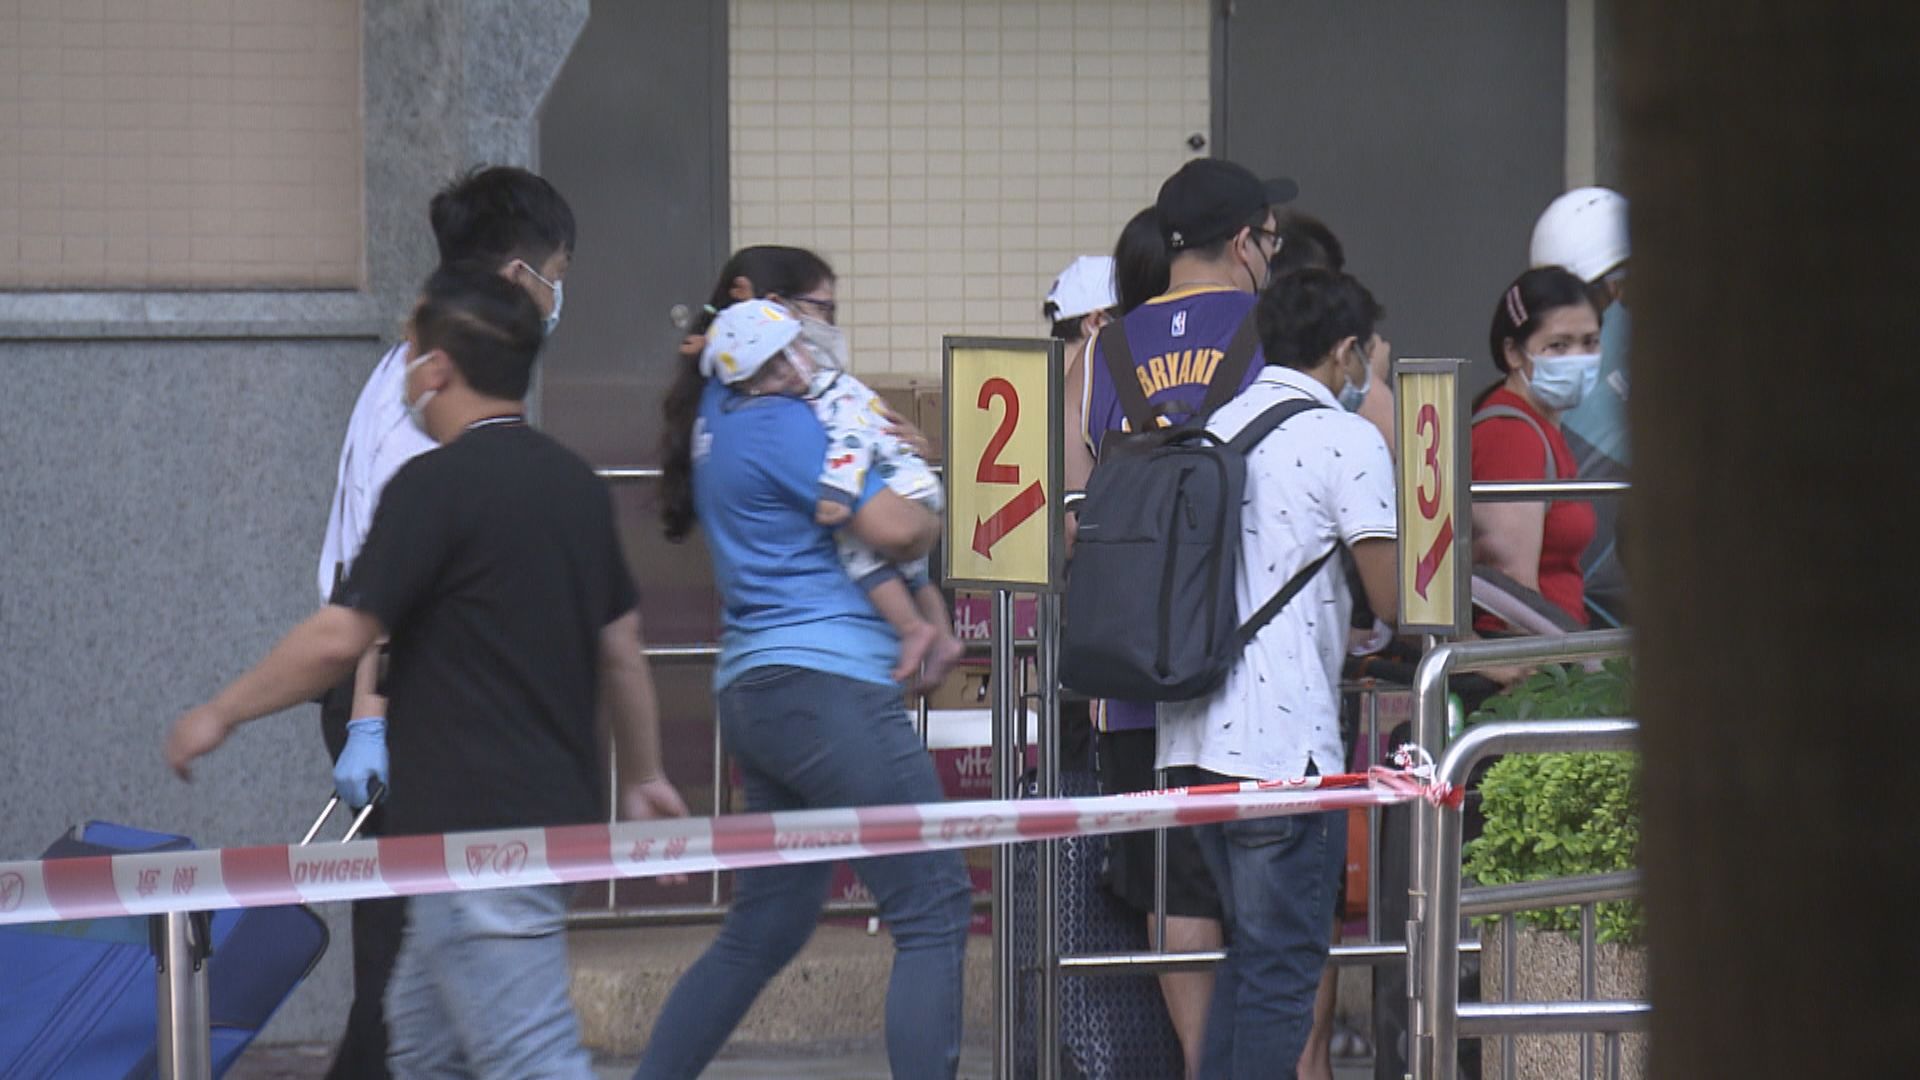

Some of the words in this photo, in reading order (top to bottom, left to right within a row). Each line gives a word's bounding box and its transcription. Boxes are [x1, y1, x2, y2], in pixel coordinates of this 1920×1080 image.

[1136, 348, 1225, 398] BRYANT
[976, 376, 1020, 485] 2
[1416, 404, 1442, 519] 3
[954, 604, 989, 639] ita
